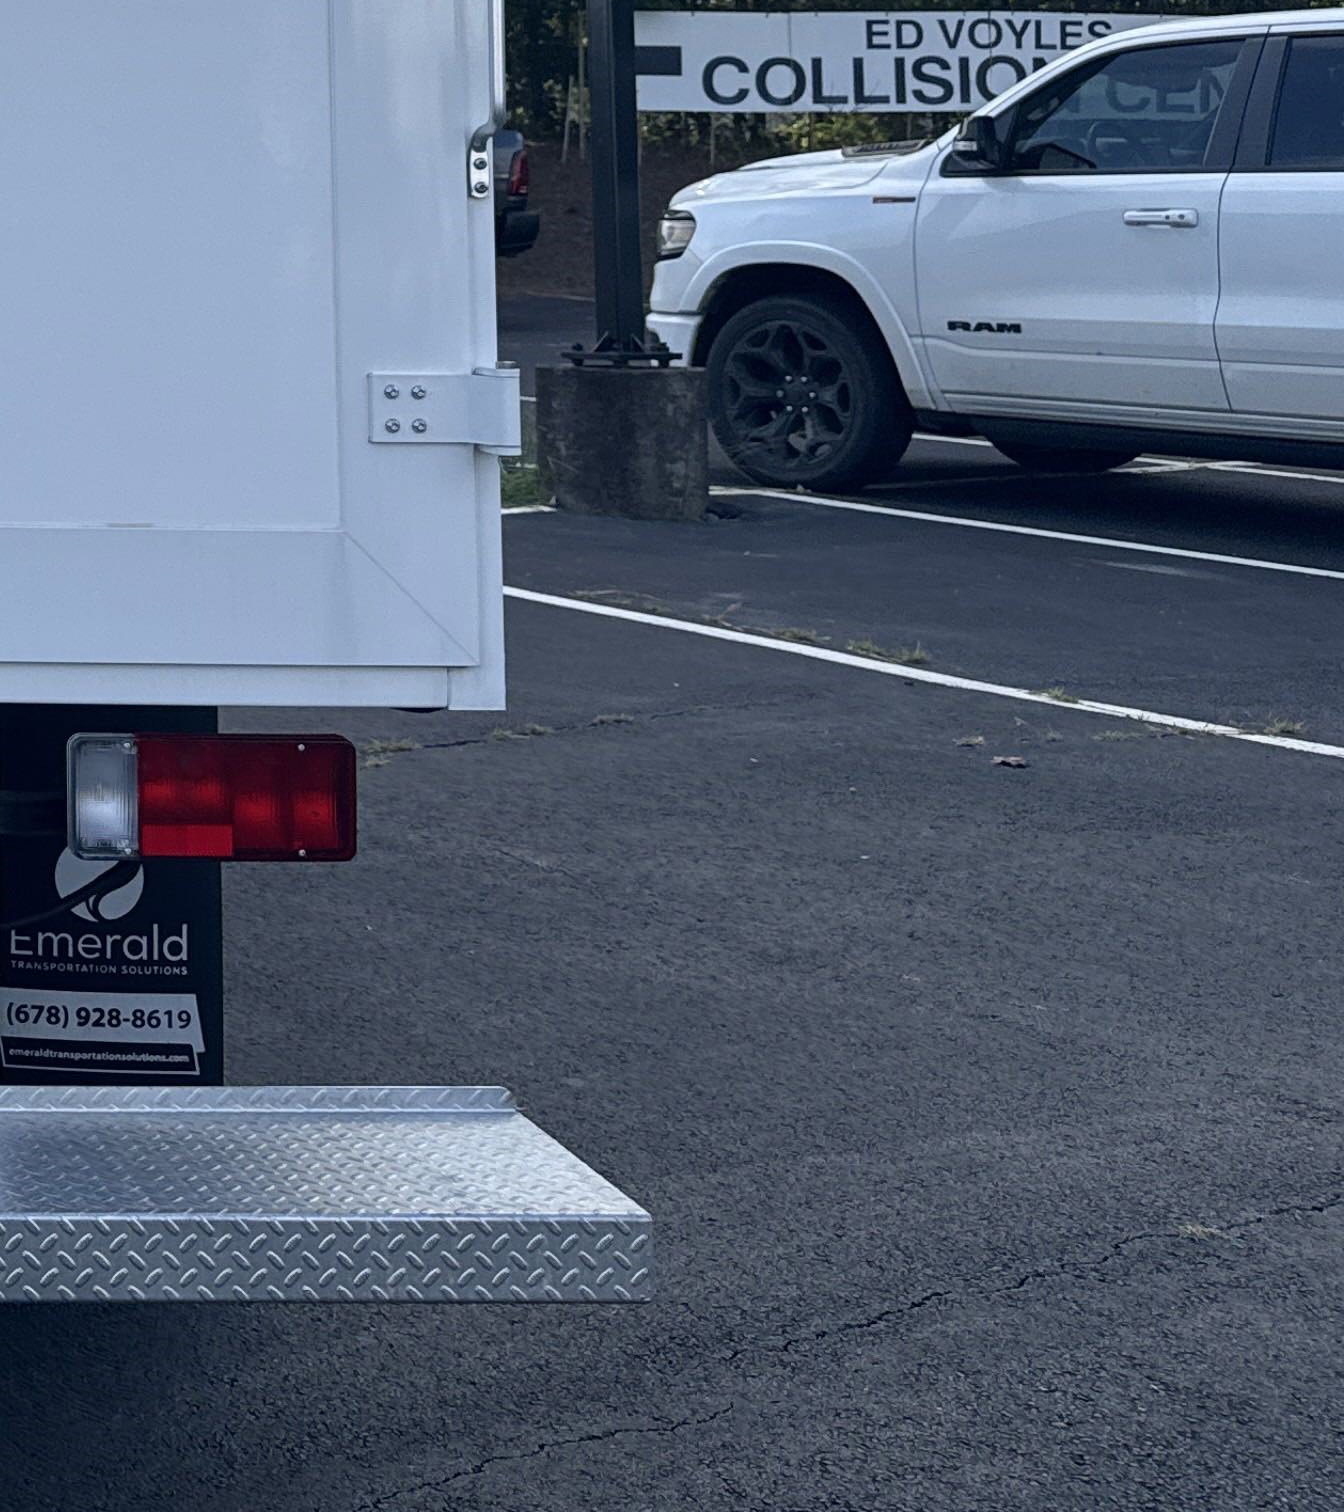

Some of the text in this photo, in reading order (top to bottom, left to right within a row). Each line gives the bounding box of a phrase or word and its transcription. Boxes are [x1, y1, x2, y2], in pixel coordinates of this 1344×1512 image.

[865, 18, 924, 50] ED
[702, 55, 1052, 106] COLLISIO
[947, 320, 1022, 334] RAM
[10, 923, 188, 962] Emerald
[11, 960, 188, 976] TRANSPORTATION SOLUTIONS
[6, 1002, 192, 1029] (678) 928-8619
